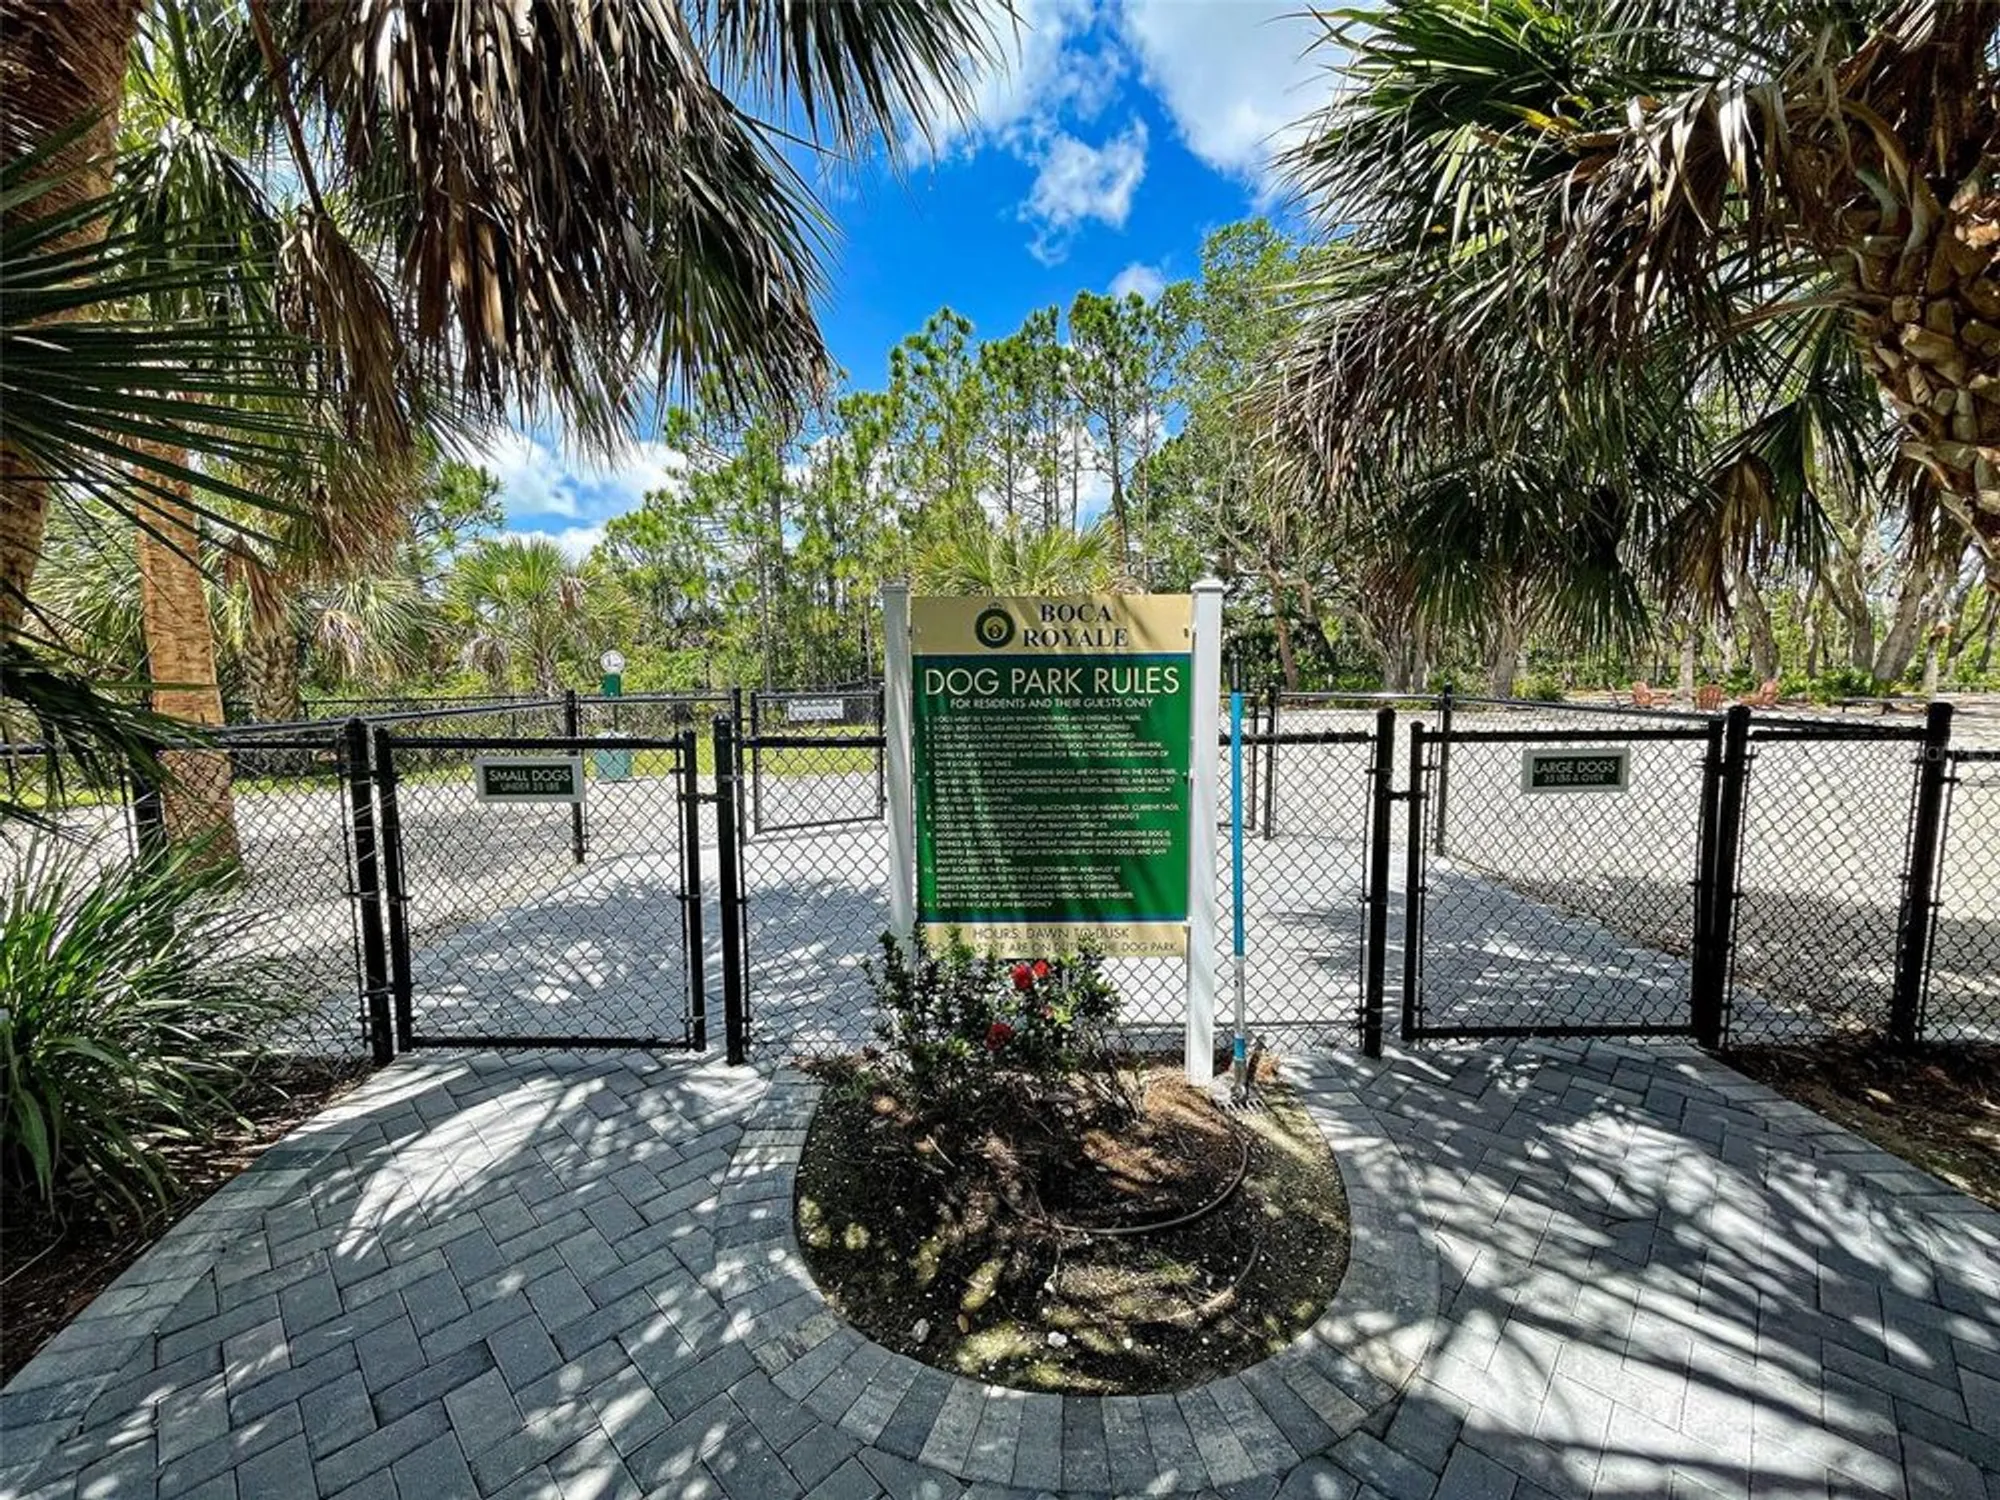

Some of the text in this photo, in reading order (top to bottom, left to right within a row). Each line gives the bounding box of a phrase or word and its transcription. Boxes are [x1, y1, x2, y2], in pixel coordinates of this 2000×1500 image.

[1040, 603, 1113, 623] BOCA
[1023, 628, 1129, 648] ROYALE
[925, 667, 1180, 695] DOG PARK RULES
[951, 697, 1153, 709] FOR RESIDENTS AND THEIR GUESTS ONLY
[1535, 760, 1616, 774] LARGE DOGS
[488, 769, 571, 781] SMALL DOGS
[1026, 928, 1069, 938] DAWN
[1096, 928, 1129, 938] DUSK
[1122, 942, 1148, 952] DOG
[1150, 942, 1177, 951] PARK
